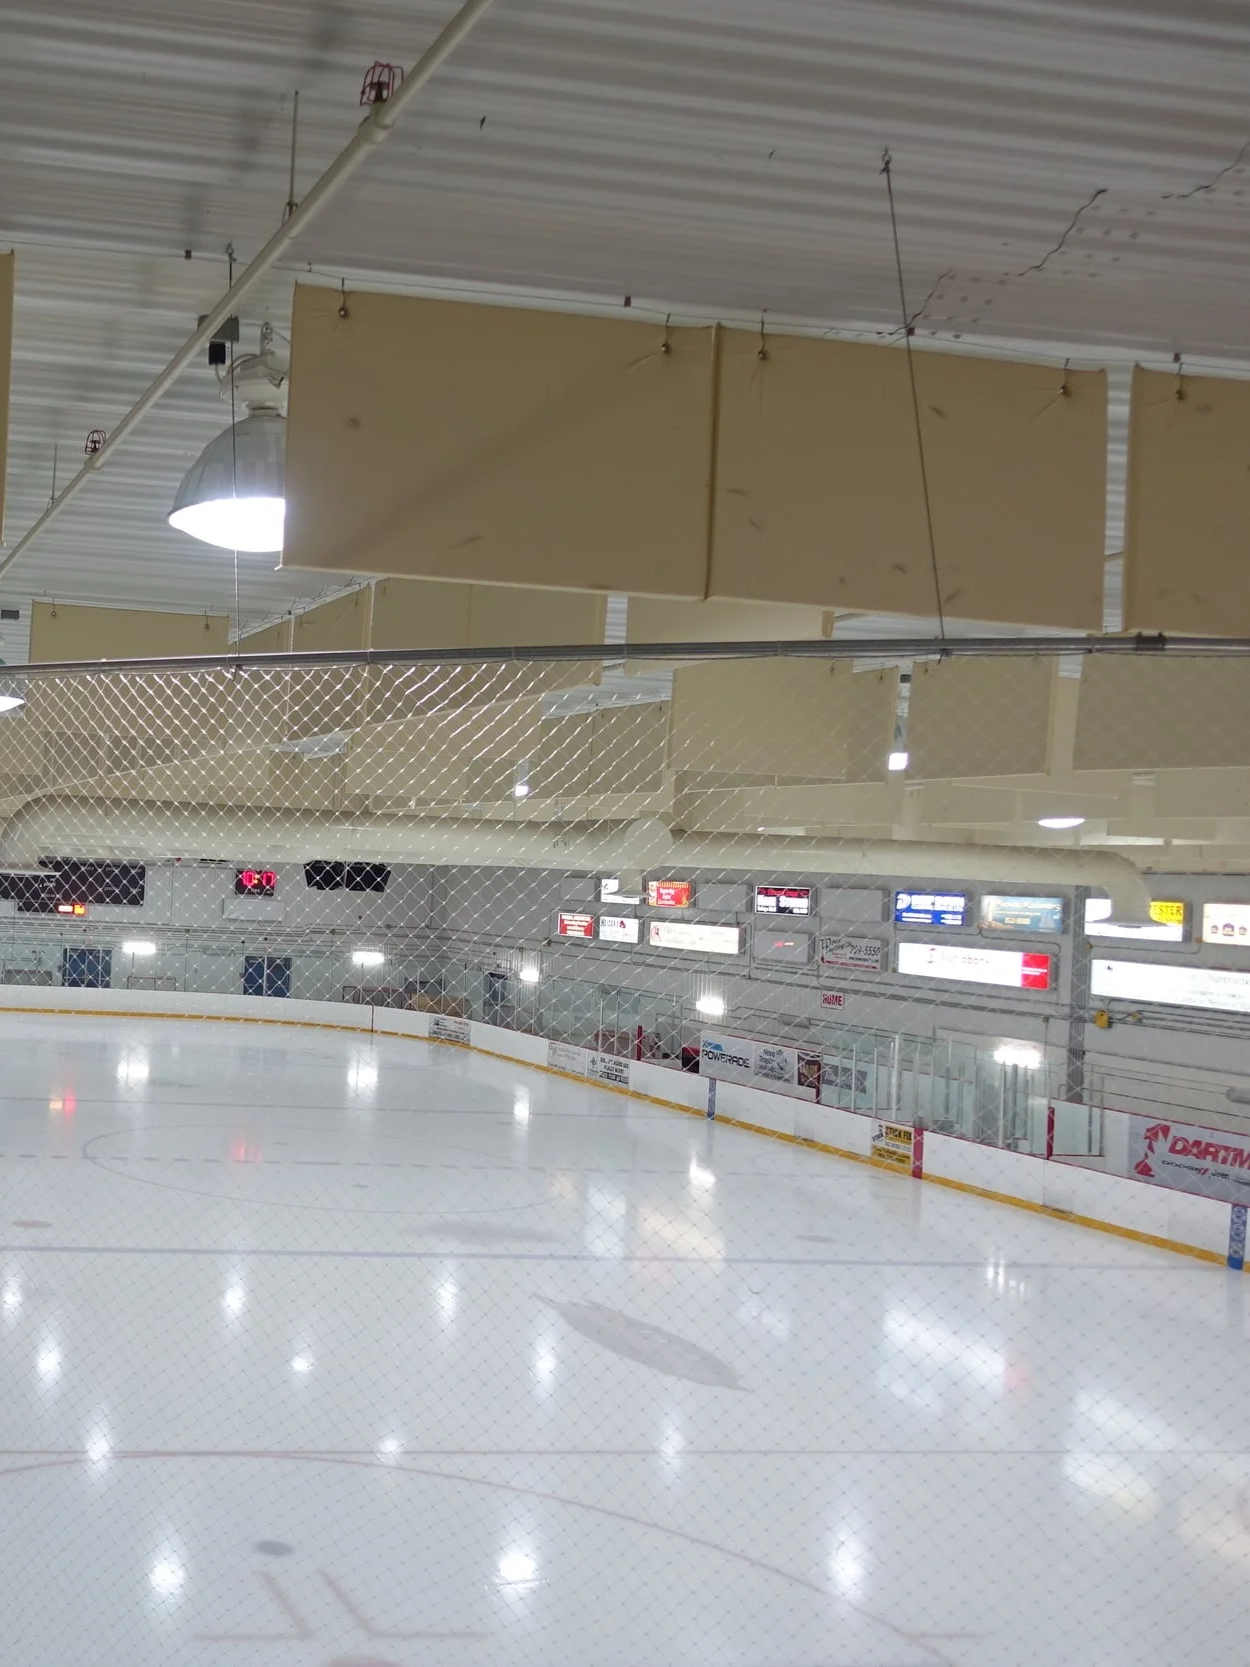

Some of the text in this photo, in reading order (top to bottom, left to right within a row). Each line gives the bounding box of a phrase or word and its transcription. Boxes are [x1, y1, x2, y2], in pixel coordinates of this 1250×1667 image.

[822, 993, 842, 1006] HOME
[702, 1049, 750, 1068] POWERADE
[1211, 1169, 1230, 1181] Jeep
